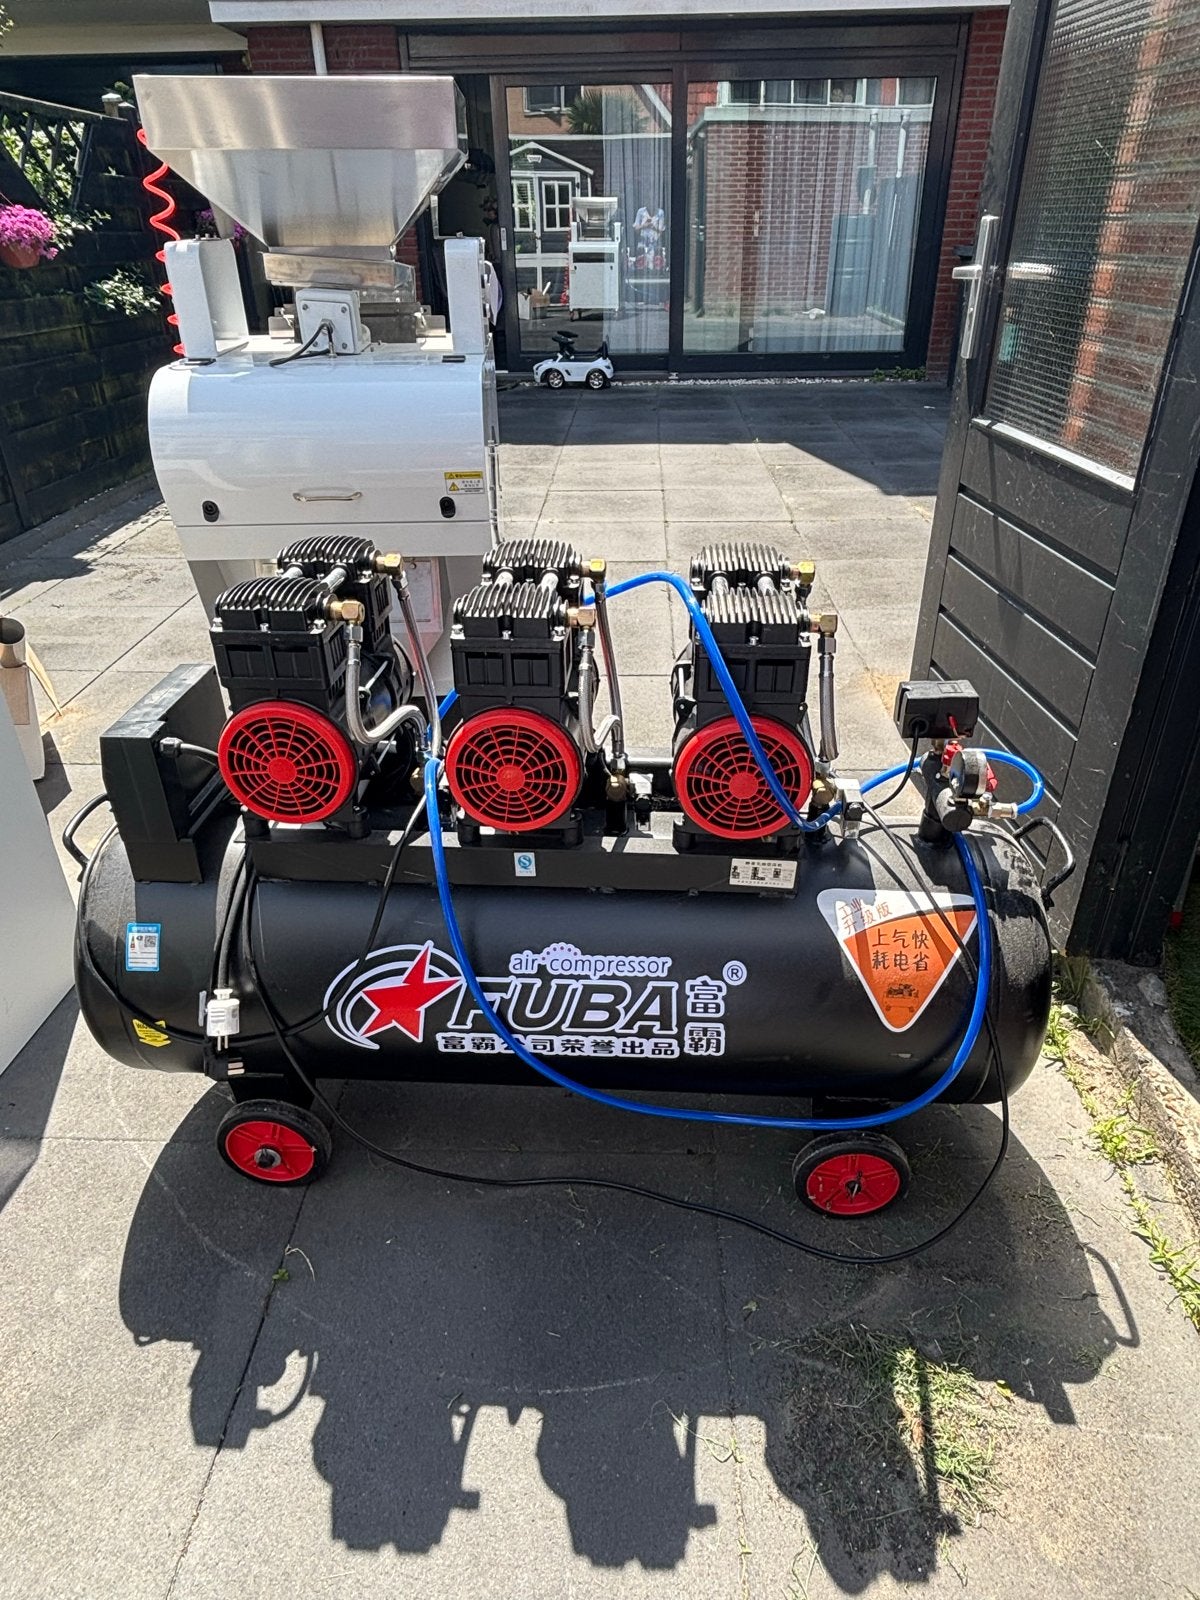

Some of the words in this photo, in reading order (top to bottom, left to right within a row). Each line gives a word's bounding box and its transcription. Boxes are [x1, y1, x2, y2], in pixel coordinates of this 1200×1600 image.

[843, 901, 893, 935] 升级版
[872, 928, 930, 950] 上气快
[512, 953, 538, 971] air
[550, 956, 669, 977] compressor
[872, 950, 930, 972] 耗电省
[448, 977, 678, 1034] FUBA
[688, 979, 724, 1054] 富霸
